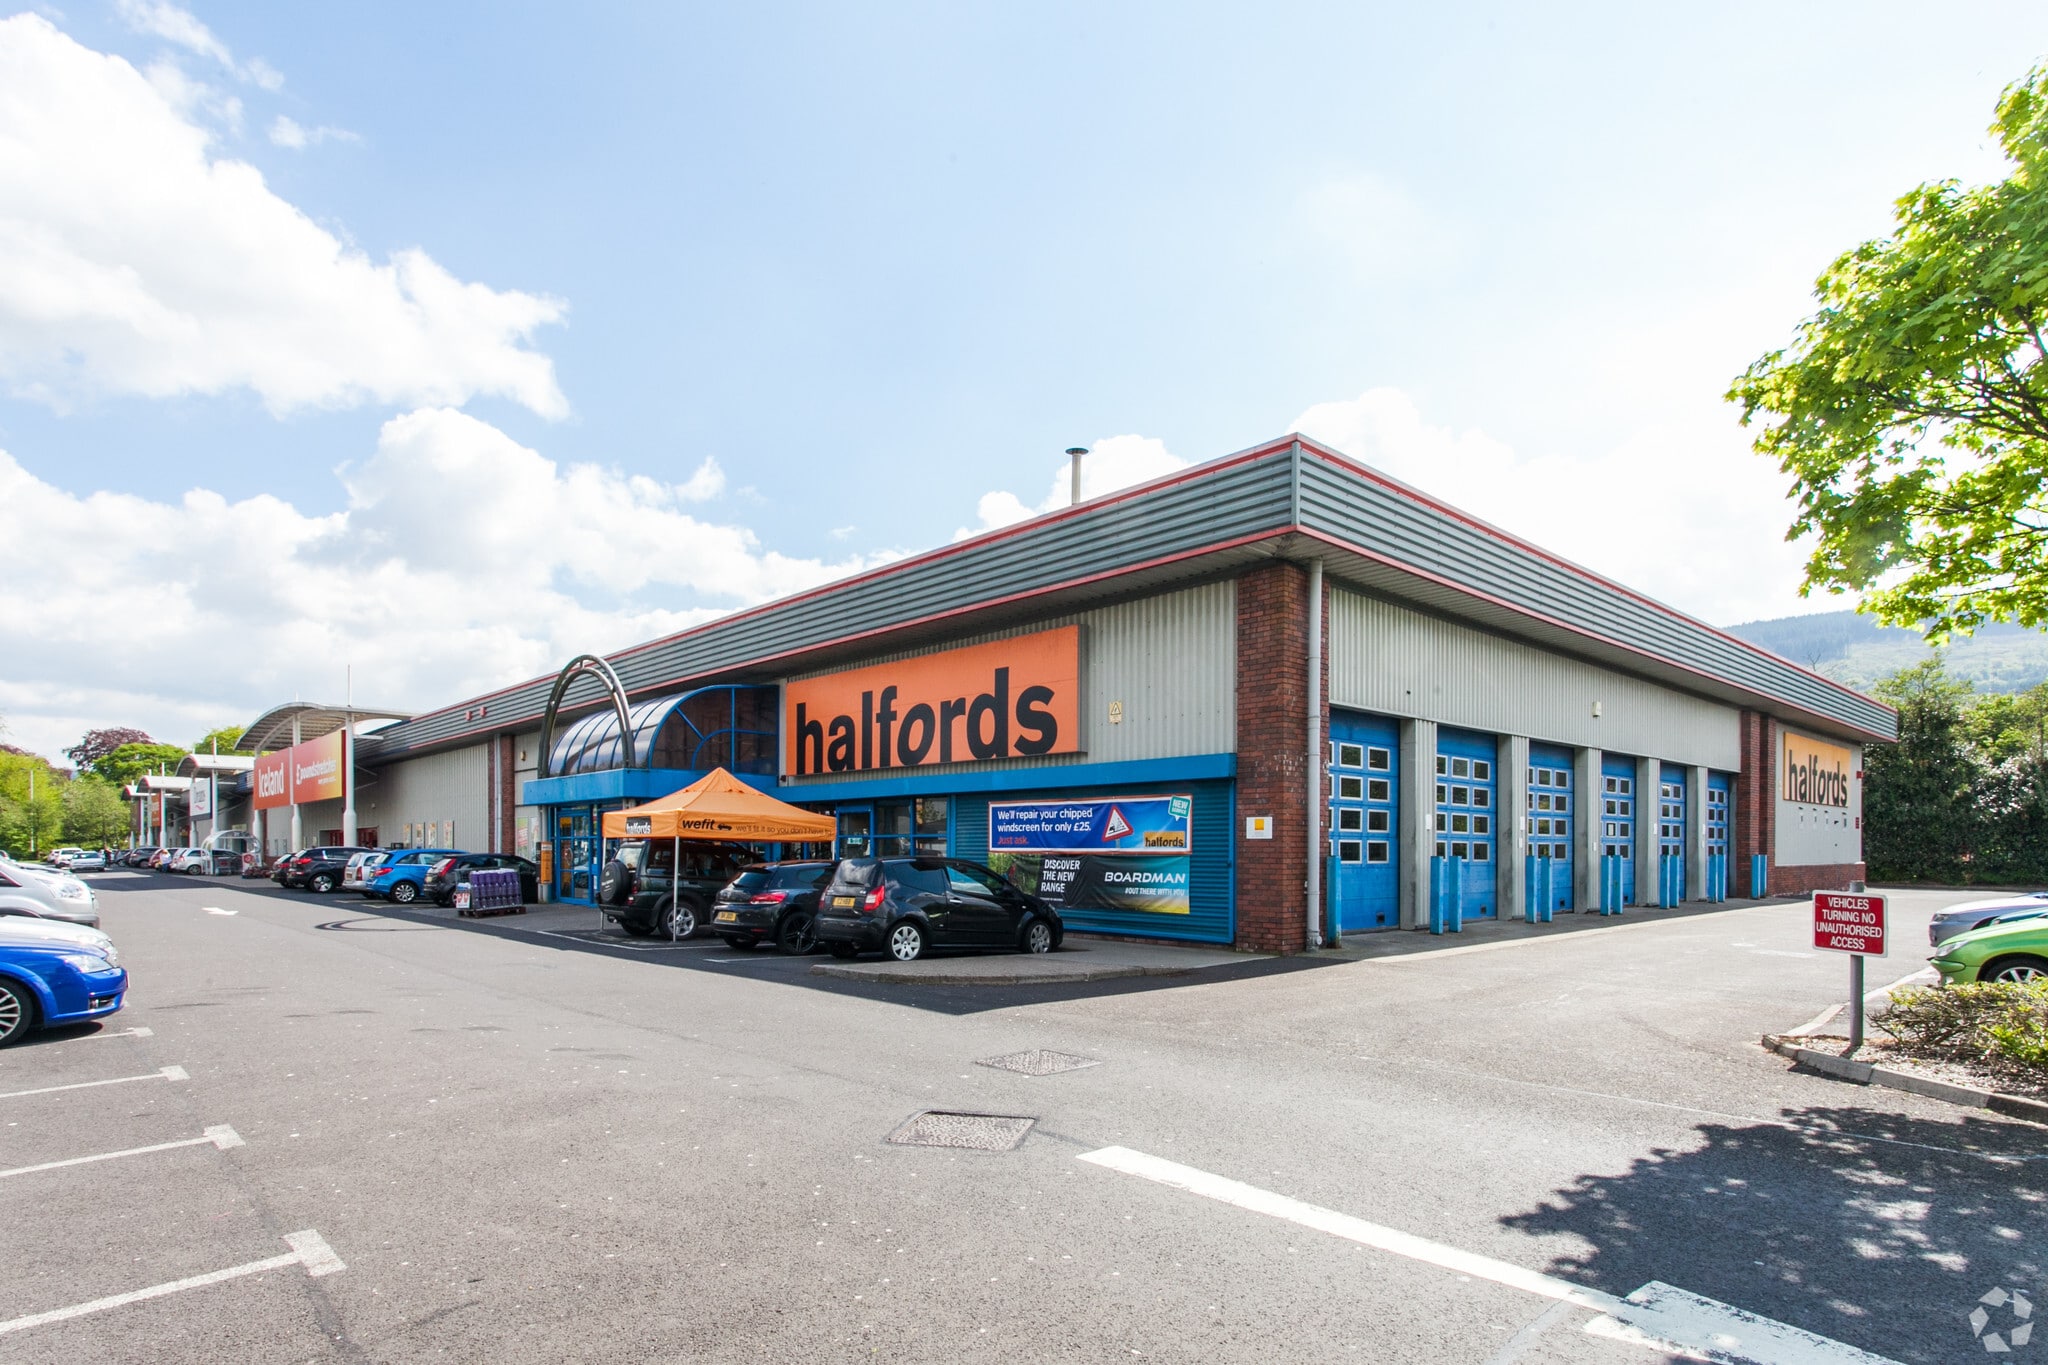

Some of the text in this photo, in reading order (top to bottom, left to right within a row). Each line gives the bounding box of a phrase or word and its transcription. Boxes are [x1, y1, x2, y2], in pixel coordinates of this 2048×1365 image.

[796, 666, 1058, 775] halfords
[258, 762, 284, 798] Iceland
[1788, 749, 1848, 807] halfords
[1172, 799, 1188, 810] NEW
[998, 808, 1093, 822] We'll repair your chipped
[626, 823, 651, 834] halfords
[682, 819, 716, 831] wefit
[777, 827, 790, 835] you
[998, 821, 1092, 833] windscreen for only £25.
[997, 835, 1030, 845] Just ask.
[1145, 837, 1184, 848] halfords
[1044, 859, 1081, 871] DISCOVER
[1042, 870, 1075, 882] THE NEW
[1103, 871, 1186, 884] BOARDMAN
[1040, 882, 1066, 893] RANGE
[1124, 887, 1185, 896] #OUT THERE WITH YOU
[1828, 897, 1869, 910] VEHICLES
[1822, 909, 1875, 924] TURNING NO
[1816, 922, 1882, 937] UNAUTHORISED
[1830, 936, 1865, 949] ACCESS
